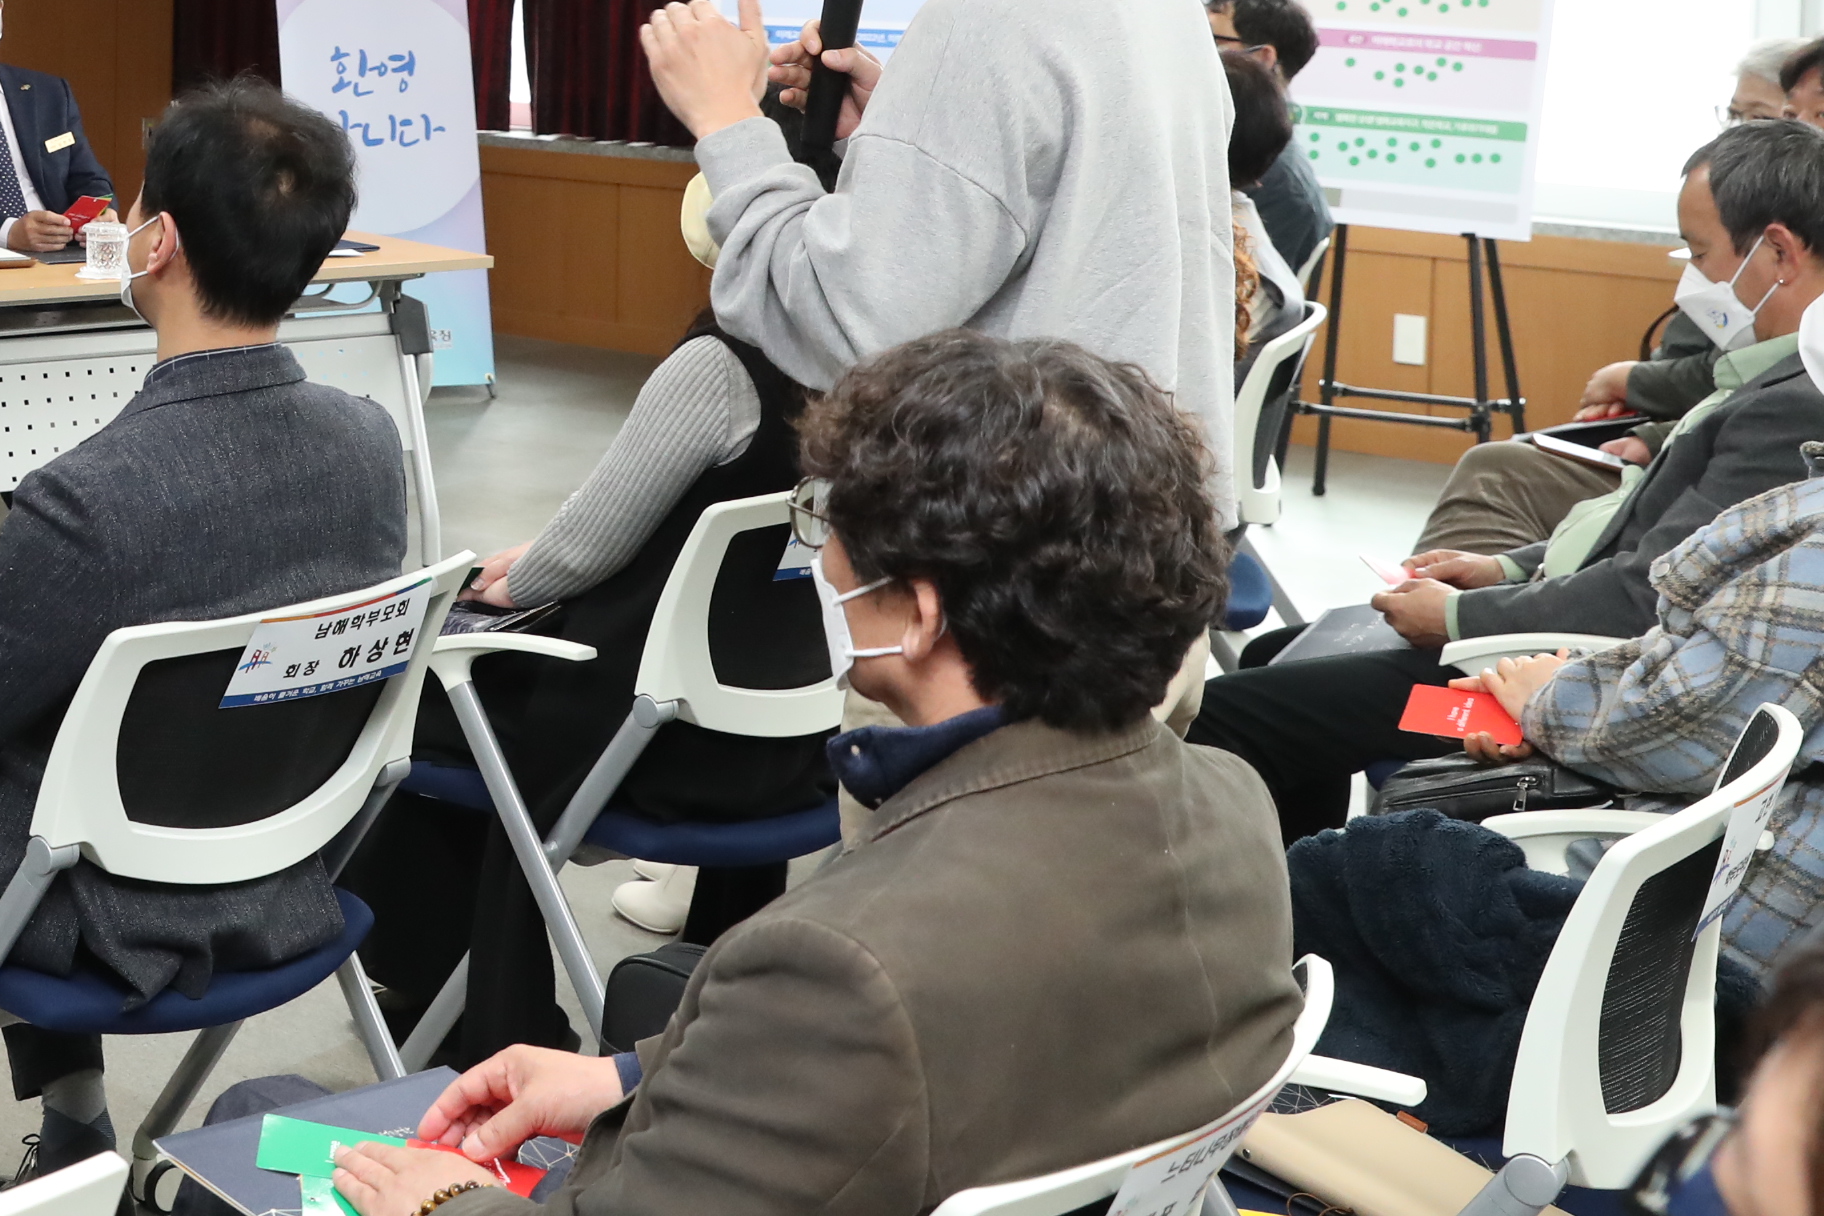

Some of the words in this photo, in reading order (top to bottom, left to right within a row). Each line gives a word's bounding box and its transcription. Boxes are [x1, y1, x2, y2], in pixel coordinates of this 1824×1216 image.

[330, 45, 416, 98] 환영
[338, 109, 446, 147] 니다
[314, 598, 411, 640] 남해학부모회
[283, 660, 321, 679] 회장
[338, 628, 416, 669] 하상현
